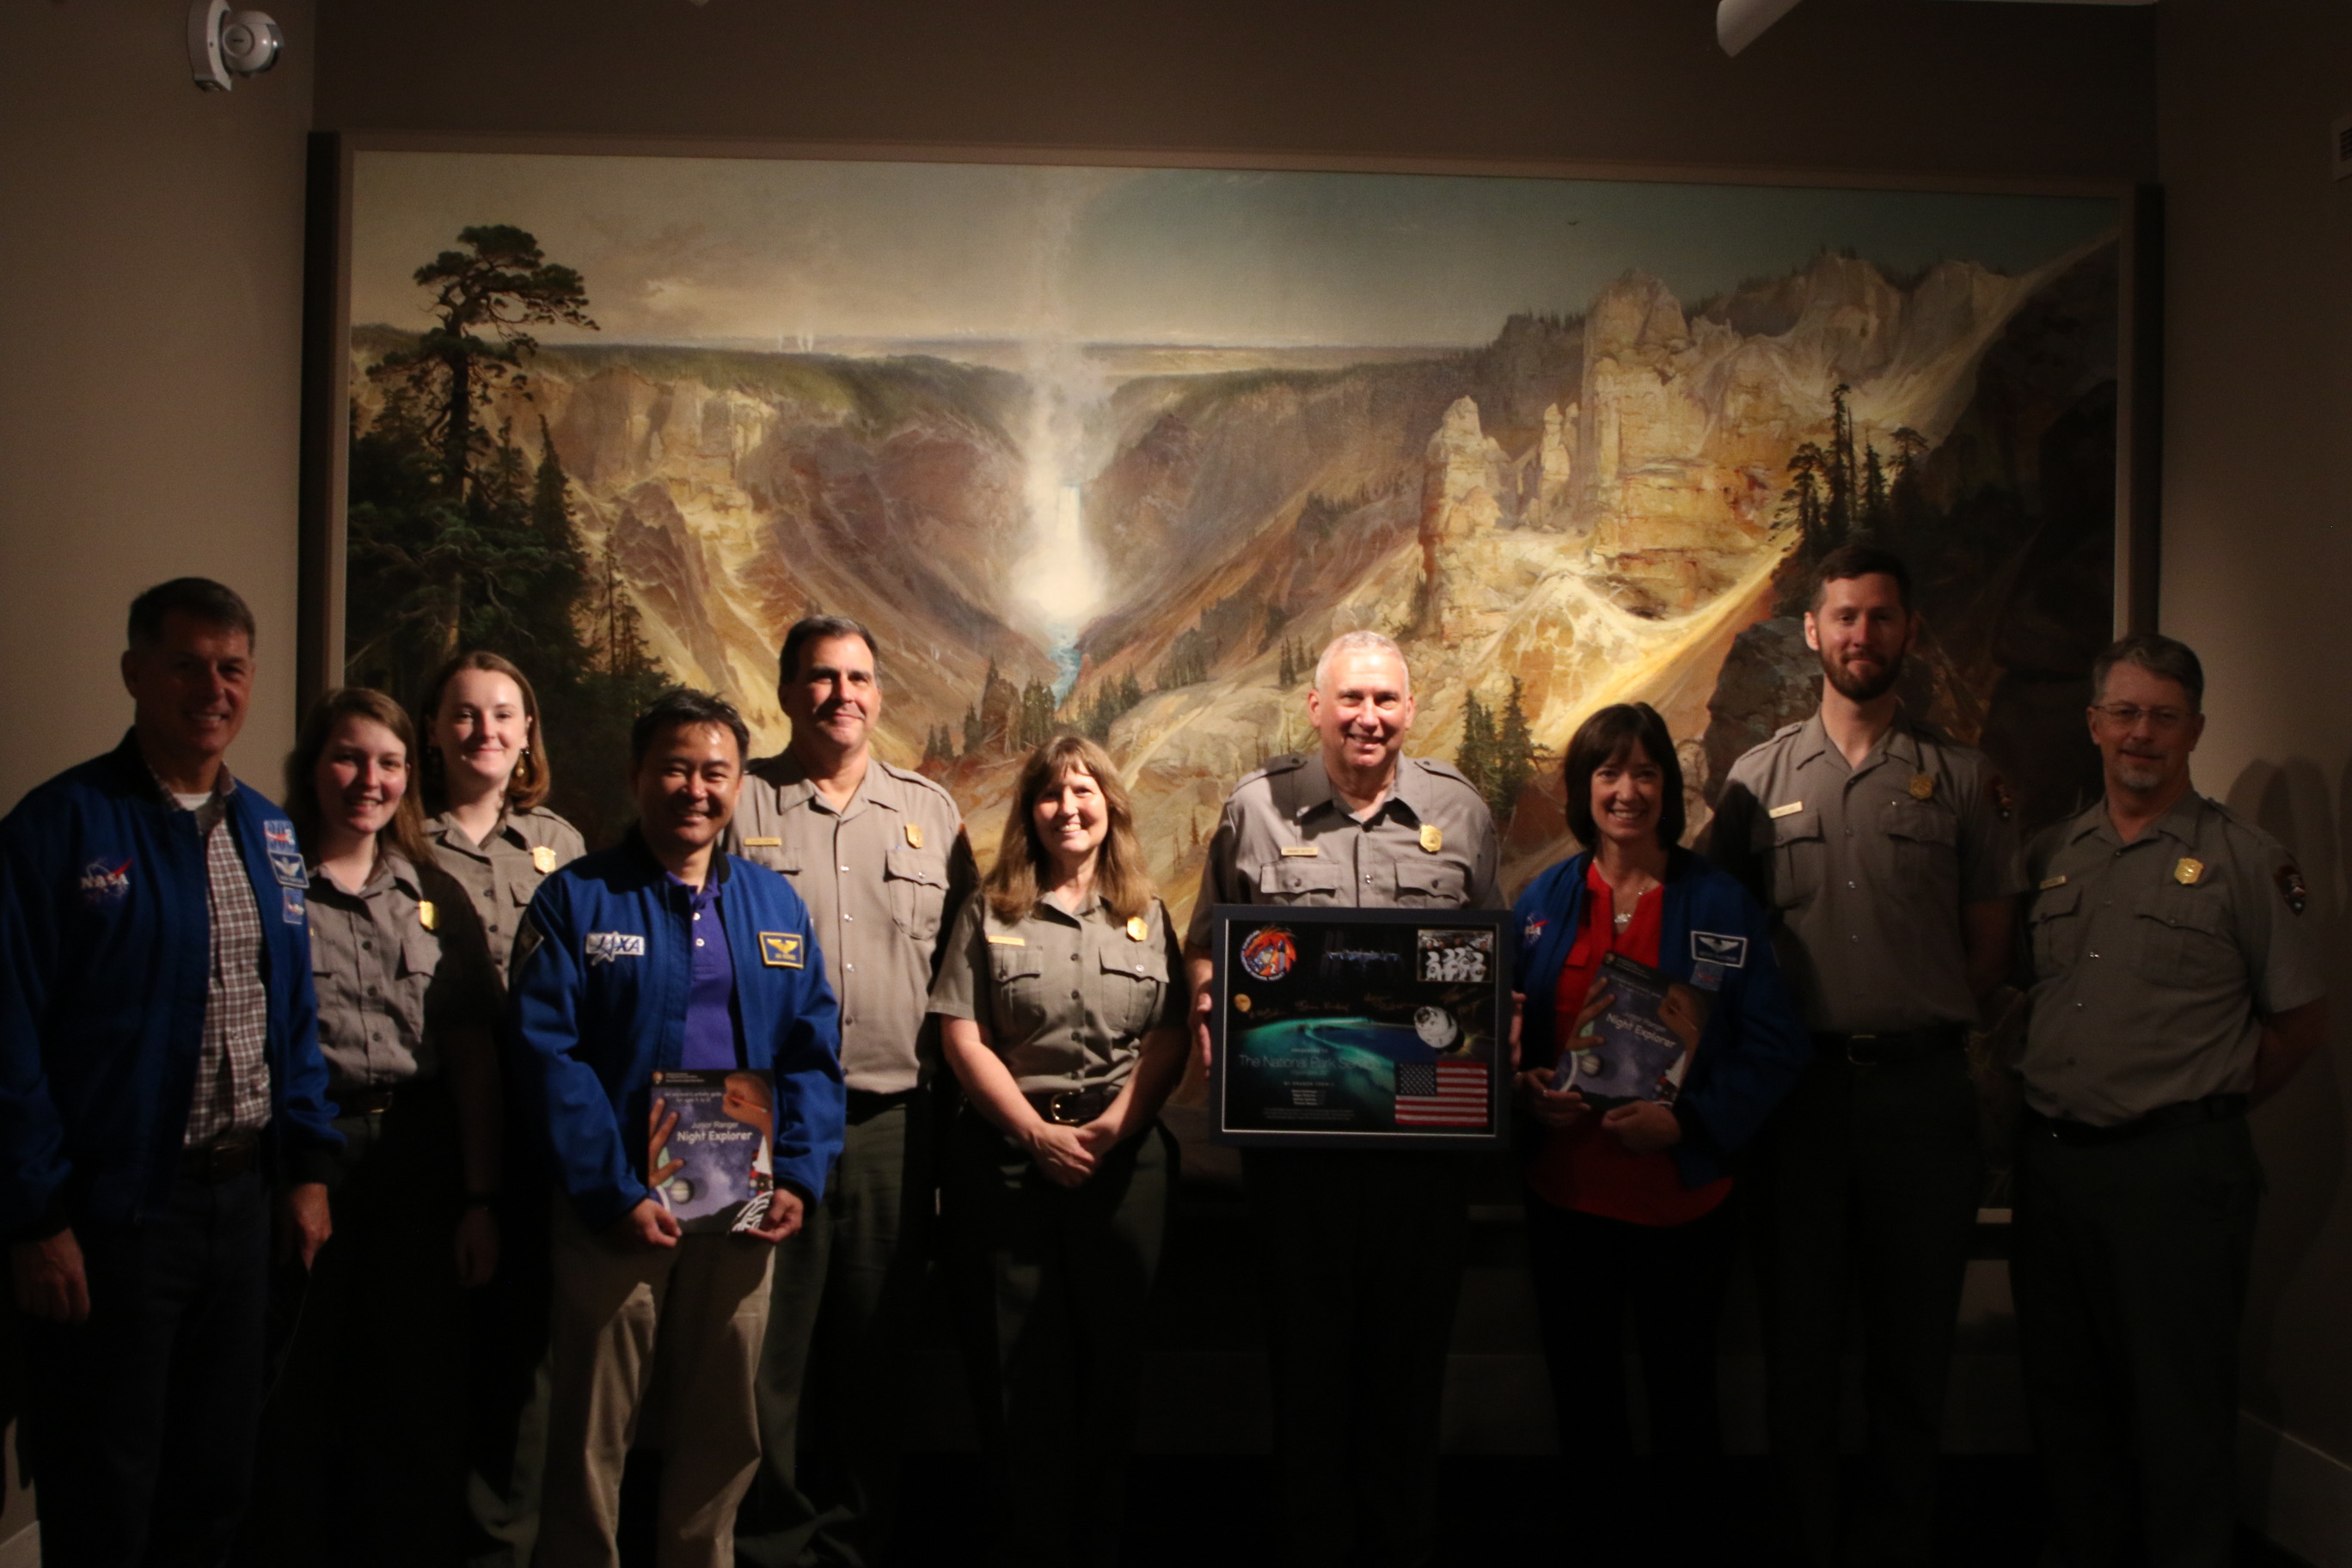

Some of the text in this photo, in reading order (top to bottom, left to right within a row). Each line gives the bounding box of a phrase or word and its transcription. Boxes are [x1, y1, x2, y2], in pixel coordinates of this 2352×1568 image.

[81, 873, 129, 888] NASA
[1606, 1013, 1676, 1048] Night Explorer
[1238, 1055, 1260, 1068] The
[1263, 1056, 1307, 1069] National
[1311, 1057, 1336, 1069] Park
[714, 1121, 739, 1130] Ranger
[677, 1130, 753, 1144] Night Explorer
